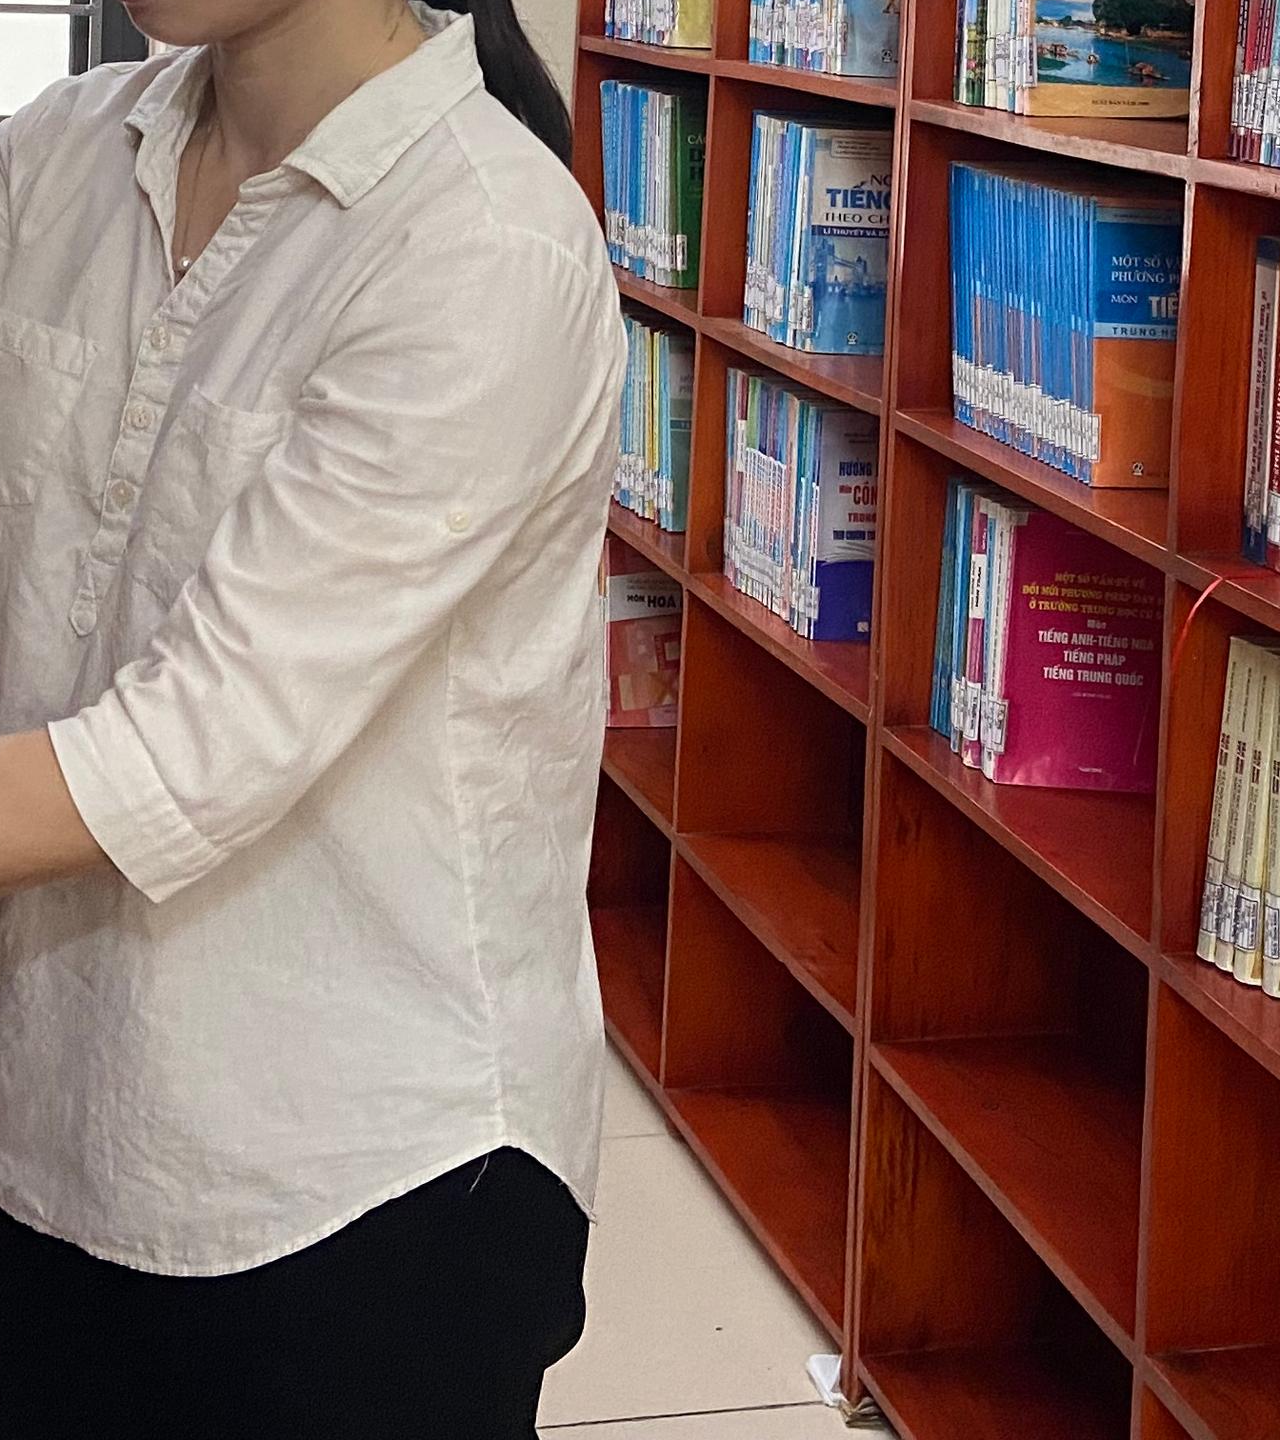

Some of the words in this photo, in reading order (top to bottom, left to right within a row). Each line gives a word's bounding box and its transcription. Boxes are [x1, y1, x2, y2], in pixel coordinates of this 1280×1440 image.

[1111, 254, 1140, 269] MỘT
[1111, 270, 1165, 284] PHƯƠNG
[1111, 293, 1138, 304] MÔN
[1112, 326, 1153, 336] TRUNG
[1038, 629, 1068, 645] TIẾNG
[1063, 648, 1094, 664] TIẾNG
[1096, 652, 1126, 667] PHÁP
[1043, 664, 1074, 681] TIẾNG
[1077, 668, 1112, 684] TRUNG
